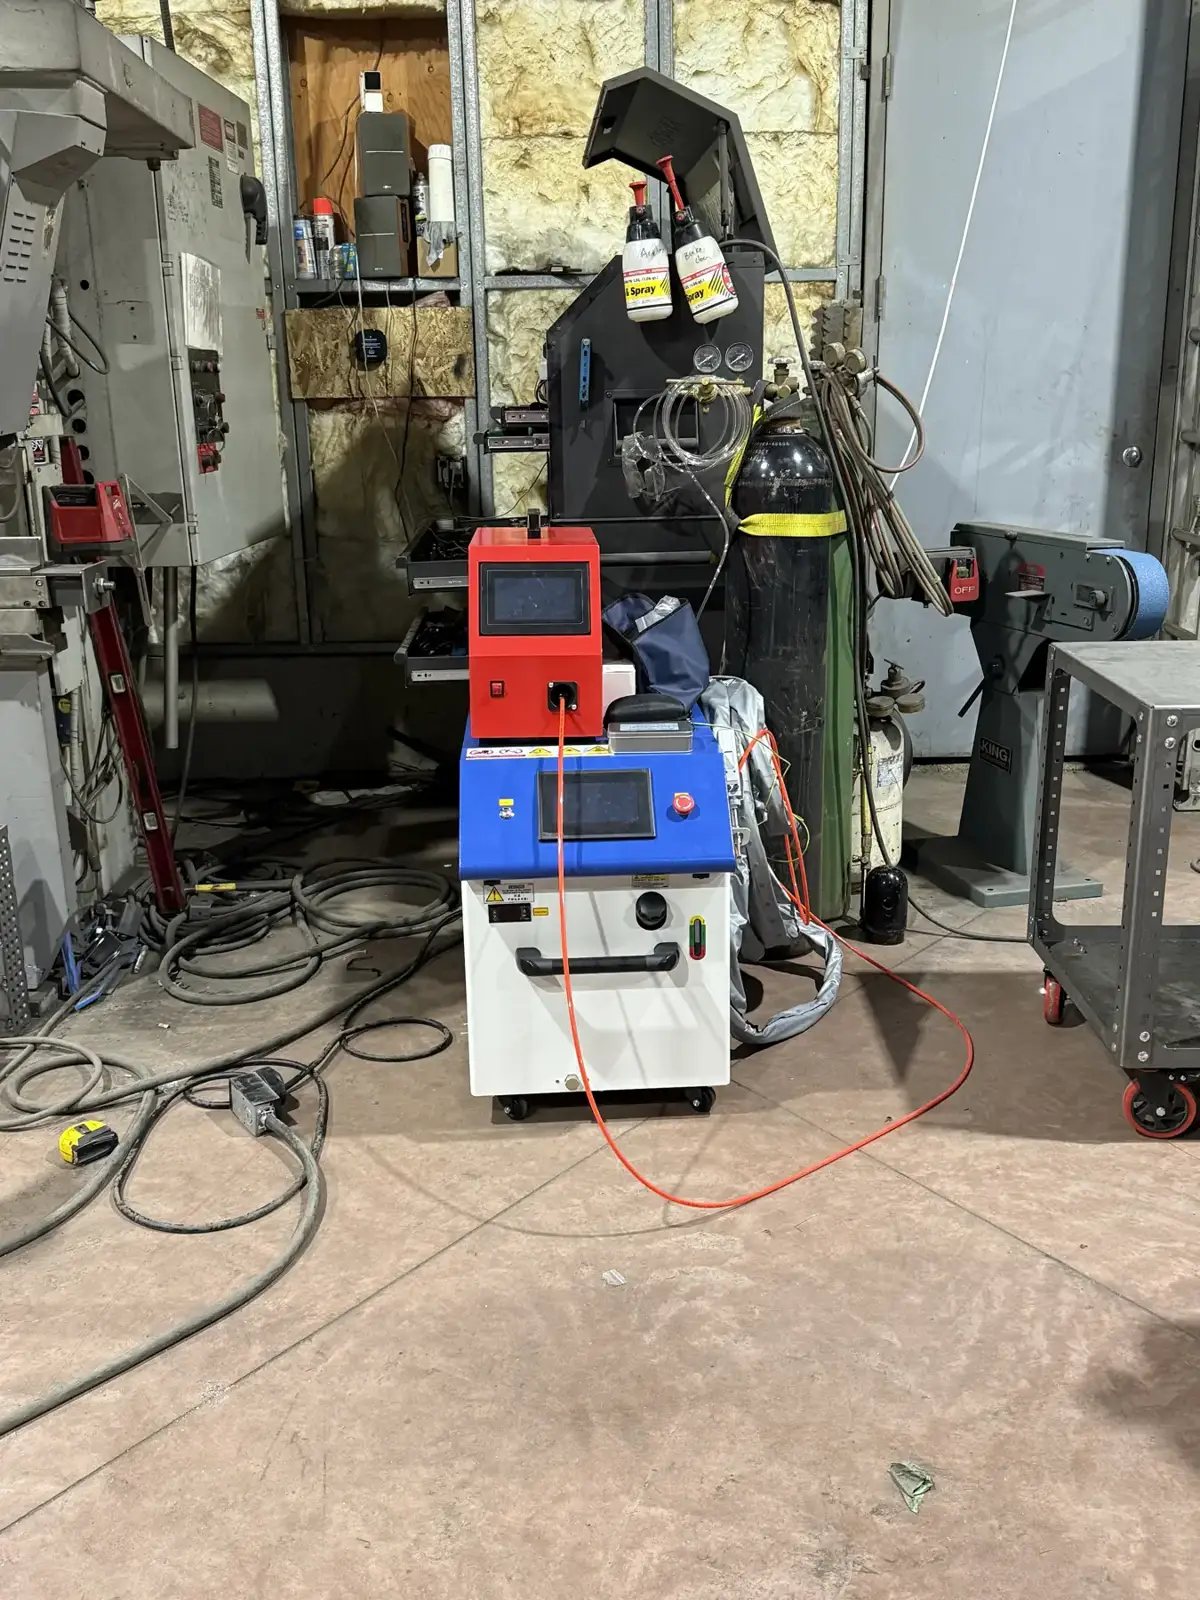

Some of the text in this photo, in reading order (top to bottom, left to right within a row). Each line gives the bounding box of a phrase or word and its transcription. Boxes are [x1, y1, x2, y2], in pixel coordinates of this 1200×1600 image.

[630, 285, 656, 297] Spray
[954, 585, 976, 595] OFF
[980, 739, 1008, 762] KING
